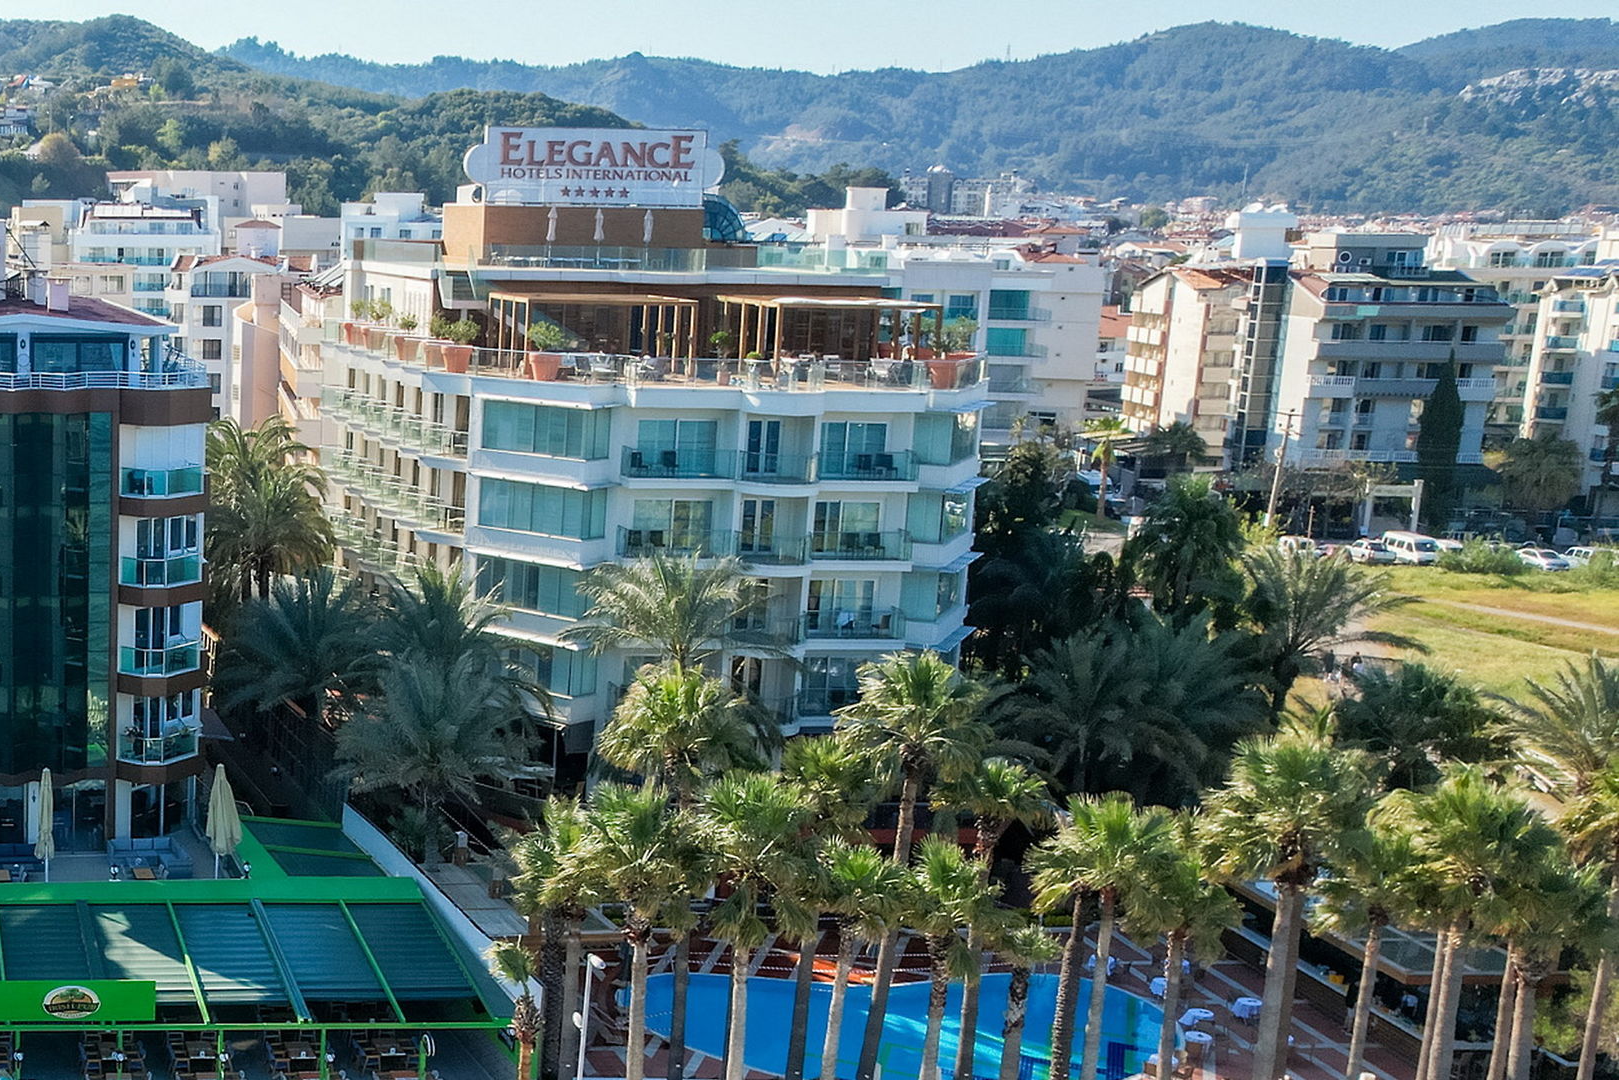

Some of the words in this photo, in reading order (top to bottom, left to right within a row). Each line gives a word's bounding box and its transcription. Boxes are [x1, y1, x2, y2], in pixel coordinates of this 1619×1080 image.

[500, 132, 695, 169] ELEGANCE
[500, 168, 562, 179] HOTELS
[566, 169, 691, 182] INTERNATIONAL
